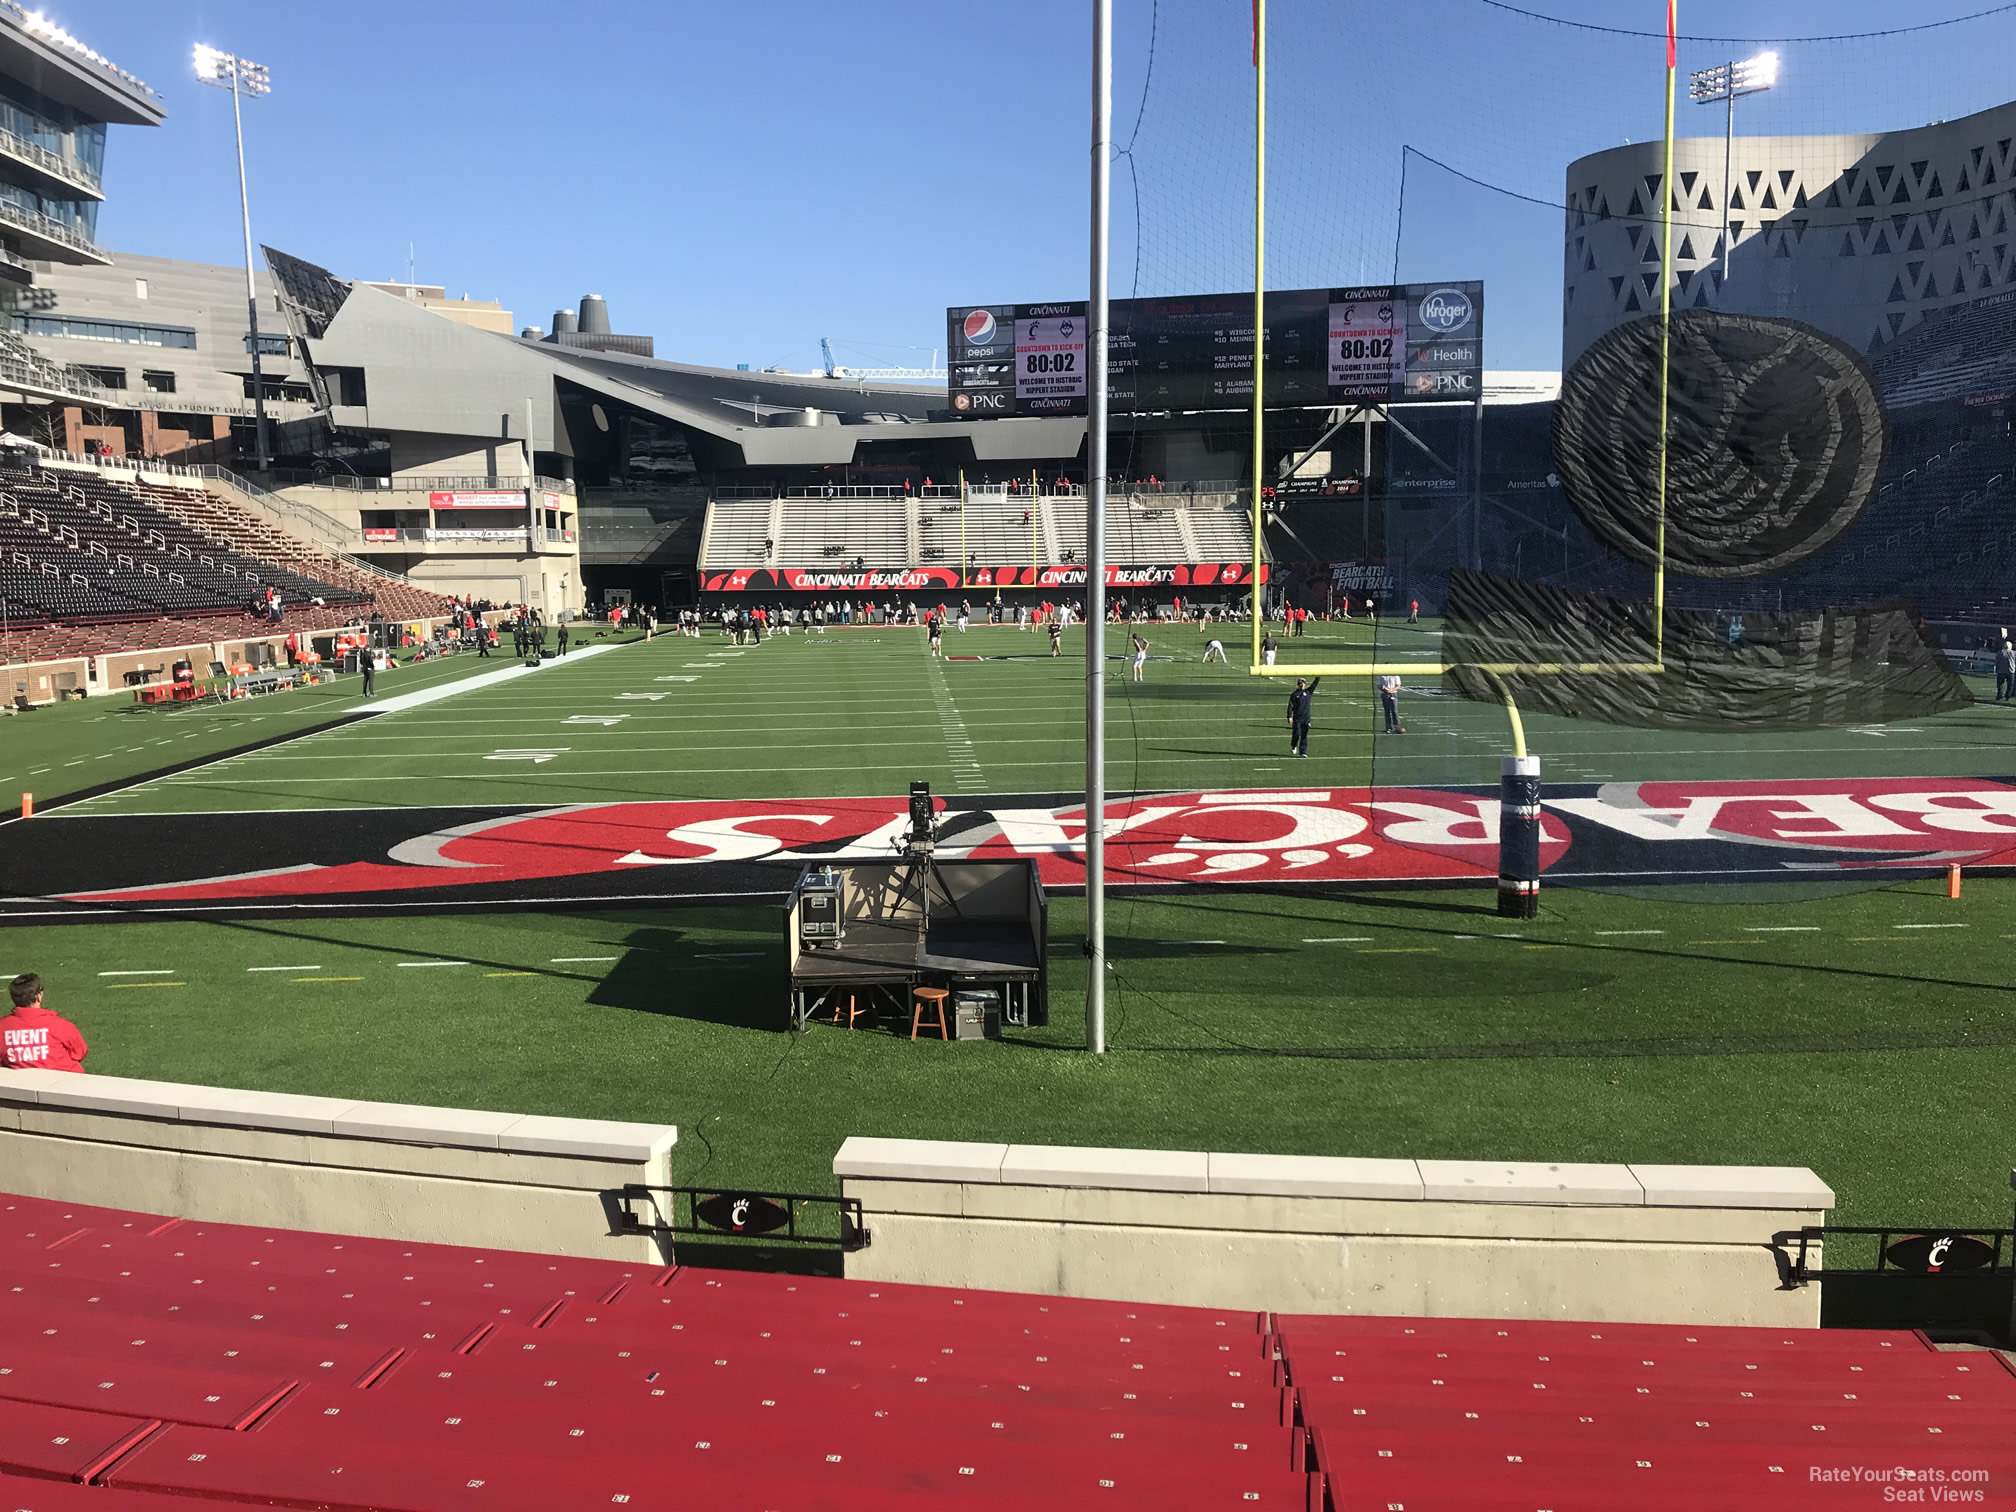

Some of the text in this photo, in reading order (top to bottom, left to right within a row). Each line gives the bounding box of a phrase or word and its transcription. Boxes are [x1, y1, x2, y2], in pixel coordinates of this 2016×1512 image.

[1344, 289, 1390, 300] CINCINNATI
[1029, 305, 1070, 316] CINCINNATI
[1426, 297, 1466, 326] Kroger
[1330, 330, 1367, 338] COUNTDOWN
[1368, 329, 1375, 337] TO
[968, 347, 994, 358] pepsi
[1341, 339, 1393, 360] 80:02
[1433, 348, 1472, 361] Health
[1027, 353, 1075, 373] 80:02
[1331, 362, 1401, 372] WELCOME TO HISTORIC
[1019, 376, 1082, 386] WELCOME TO HISTORIC
[1339, 372, 1393, 381] NIPPERT STADIUM
[1435, 375, 1473, 390] PNC
[1026, 385, 1076, 394] NIPPERT STADIUM
[1343, 386, 1388, 396] CINCINNATI
[972, 394, 1005, 408] PNC
[1030, 399, 1072, 409] CINCINNATI
[178, 404, 221, 413] STUDENT
[1396, 478, 1456, 489] enterprise
[1507, 480, 1546, 489] Ameritas
[1261, 487, 1275, 498] 25
[1114, 568, 1175, 583] BEARCATS
[1332, 566, 1385, 580] BEARCATS
[795, 571, 929, 587] CINCINNATI BEARCATS
[1336, 576, 1394, 591] FOOTBALL
[613, 790, 2016, 868] BEARCATS
[4, 1028, 49, 1046] EVENT
[7, 1045, 49, 1063] STAFF
